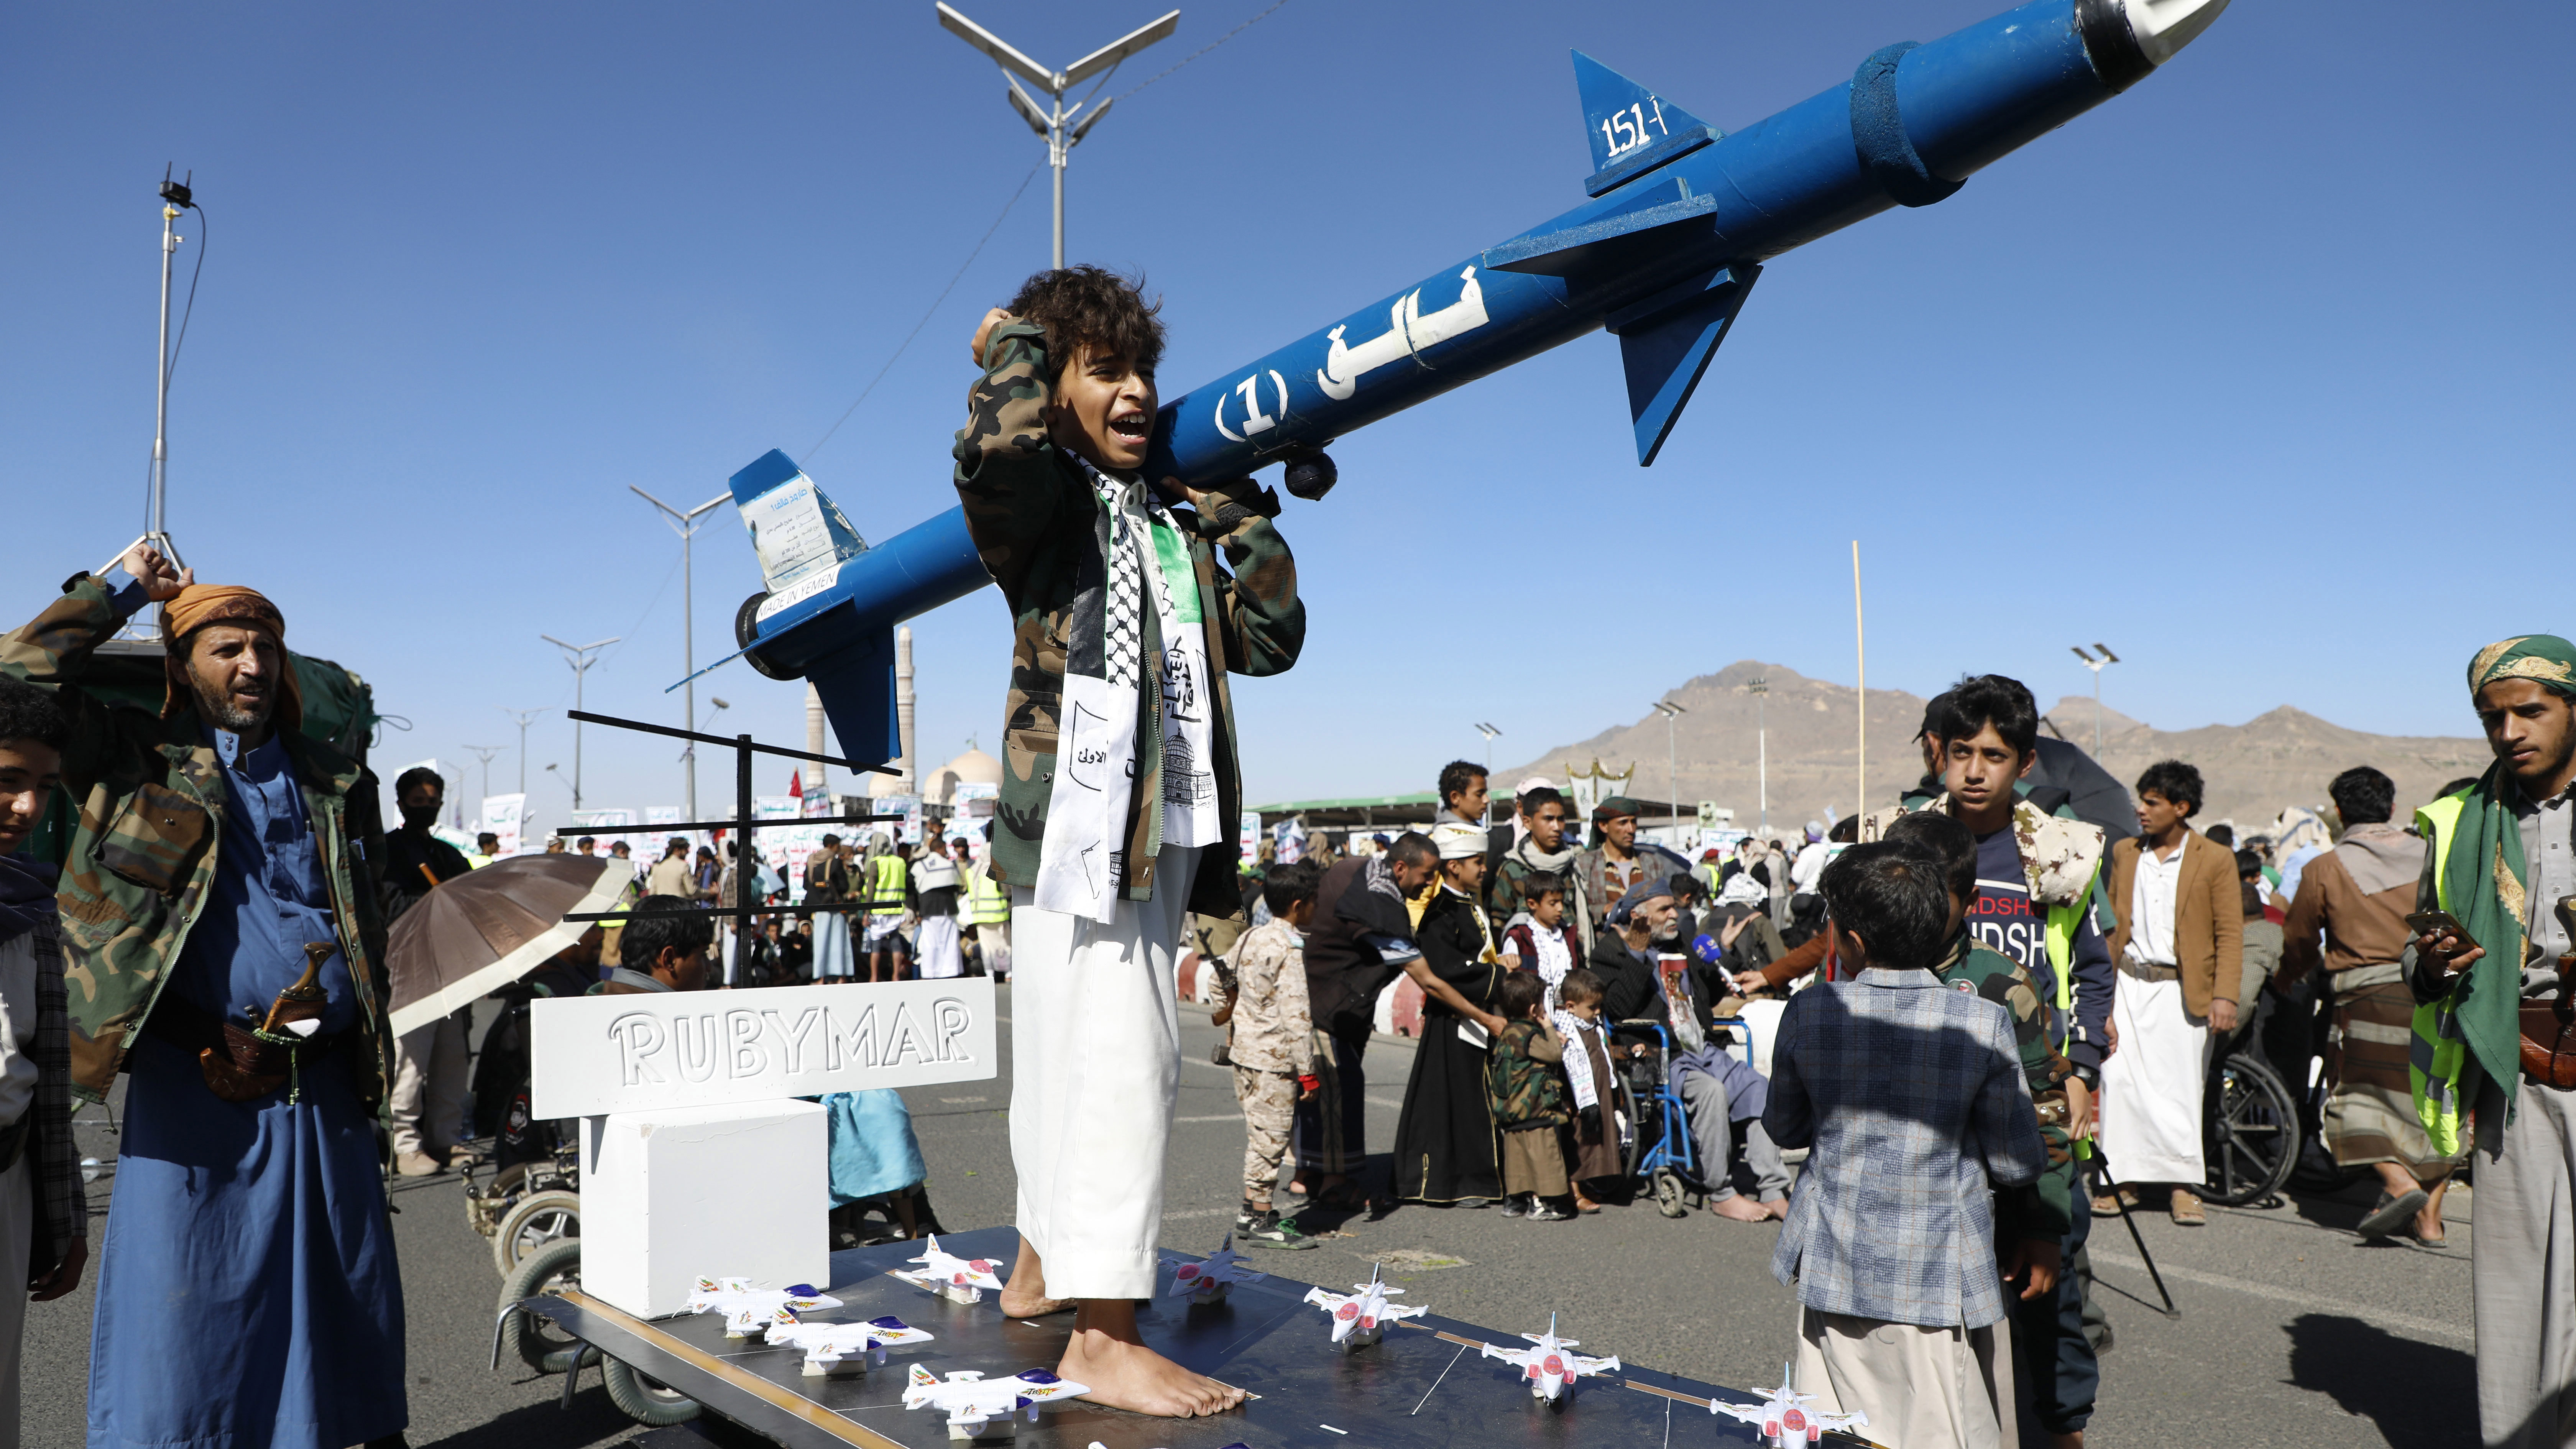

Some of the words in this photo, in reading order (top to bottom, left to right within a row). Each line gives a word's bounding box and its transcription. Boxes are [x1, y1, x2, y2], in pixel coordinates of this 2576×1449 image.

[1215, 369, 1289, 443] (1)
[789, 488, 808, 504] صاروخ
[757, 594, 785, 619] MADE
[787, 589, 798, 605] IN
[801, 570, 836, 596] YEMEN
[610, 997, 974, 1088] RUBYMAR
